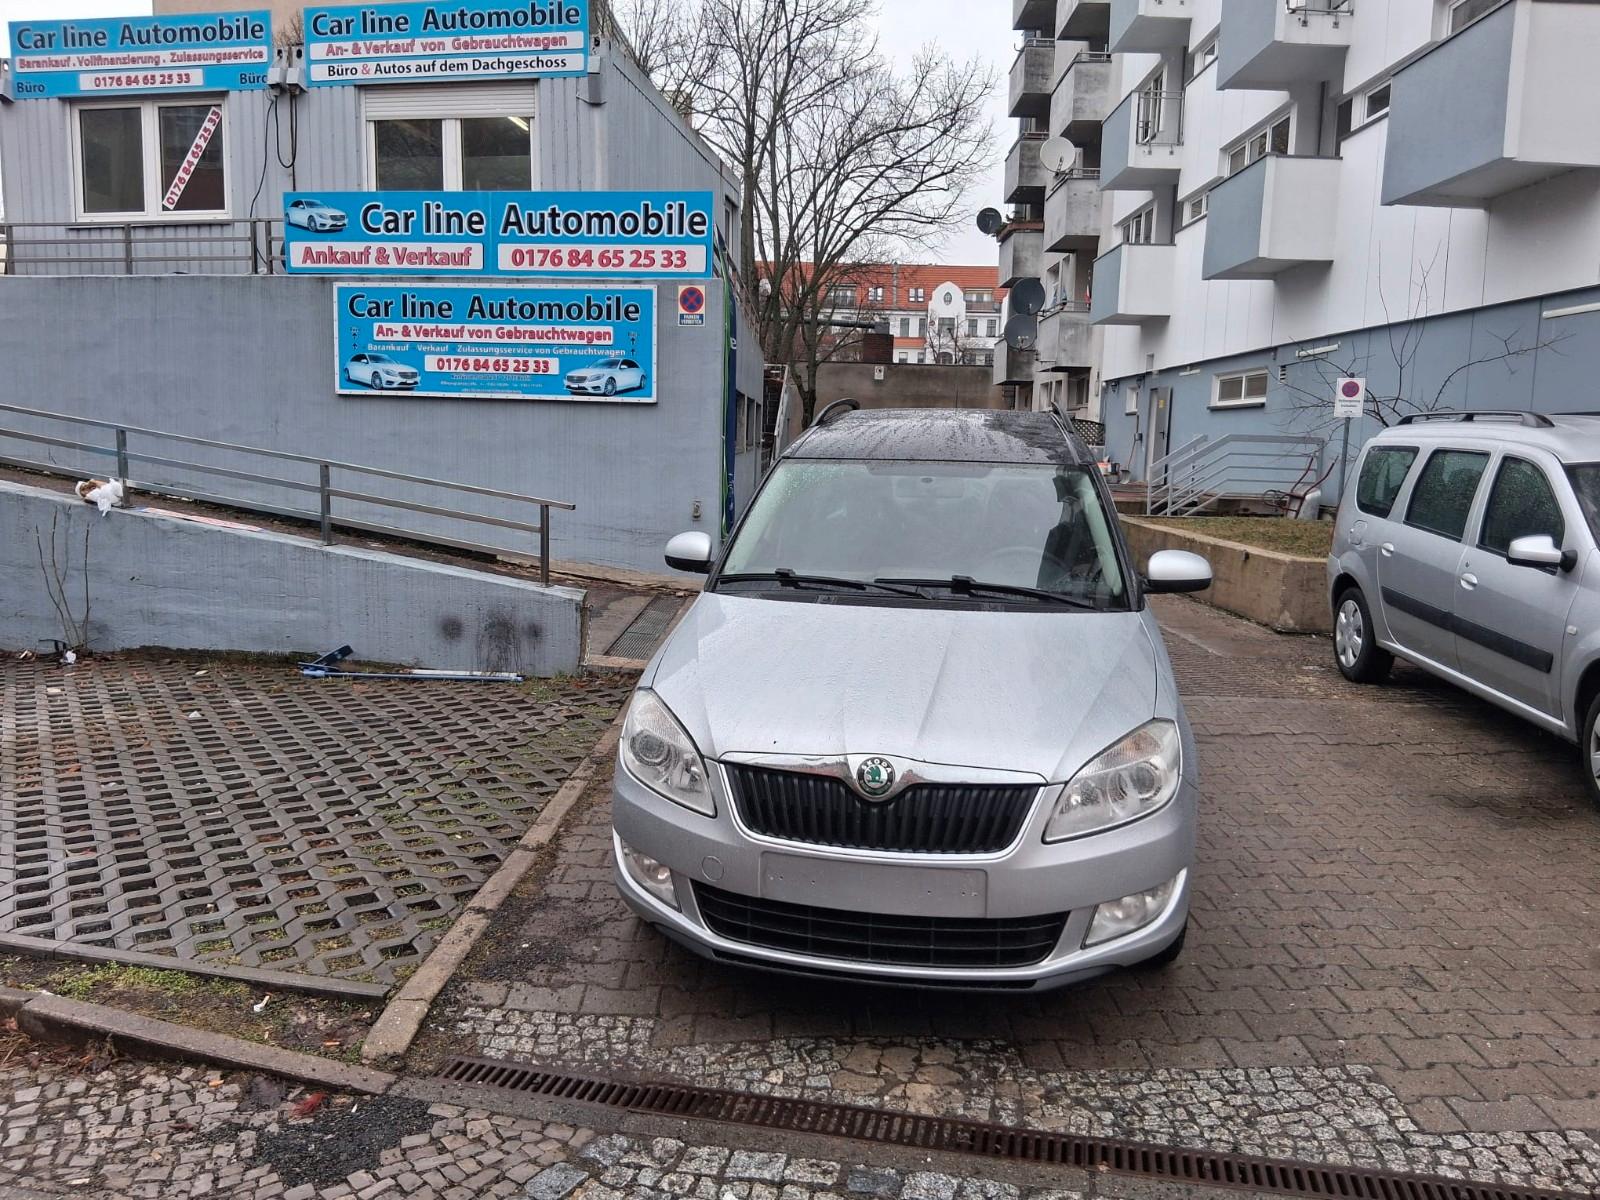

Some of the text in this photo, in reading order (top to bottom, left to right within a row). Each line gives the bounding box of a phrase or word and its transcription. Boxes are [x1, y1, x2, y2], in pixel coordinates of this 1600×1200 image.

[312, 1, 580, 36] Car line Automobile
[17, 17, 264, 49] Car line Automobile
[325, 34, 568, 56] An- & Verkauf von Gebrauchtwagen
[19, 56, 71, 69] Barankauf
[77, 54, 160, 66] Vollfinanzierung
[170, 49, 264, 63] Zulassungsservice
[328, 56, 567, 77] Büro & Autos auf dem Dachgeschoss
[17, 81, 45, 93] Büro
[94, 73, 191, 87] 0176 84 65 25 33
[166, 110, 221, 205] 0176 84 65 25 33
[361, 203, 707, 235] Car line Automobile
[302, 245, 472, 266] Ankauf & Verkauf
[511, 249, 687, 268] 0176 84 65 25 33
[349, 293, 640, 321] Car line Automobile
[376, 324, 612, 344] An- & Verkauf von Gebrauchtwagen
[368, 343, 409, 352] Barankauf
[416, 343, 449, 352] Verkauf
[457, 344, 533, 355] Zulassungsservice
[552, 346, 626, 358] Gebrauchtwagen
[436, 357, 550, 373] 0176 84 65 25 33
